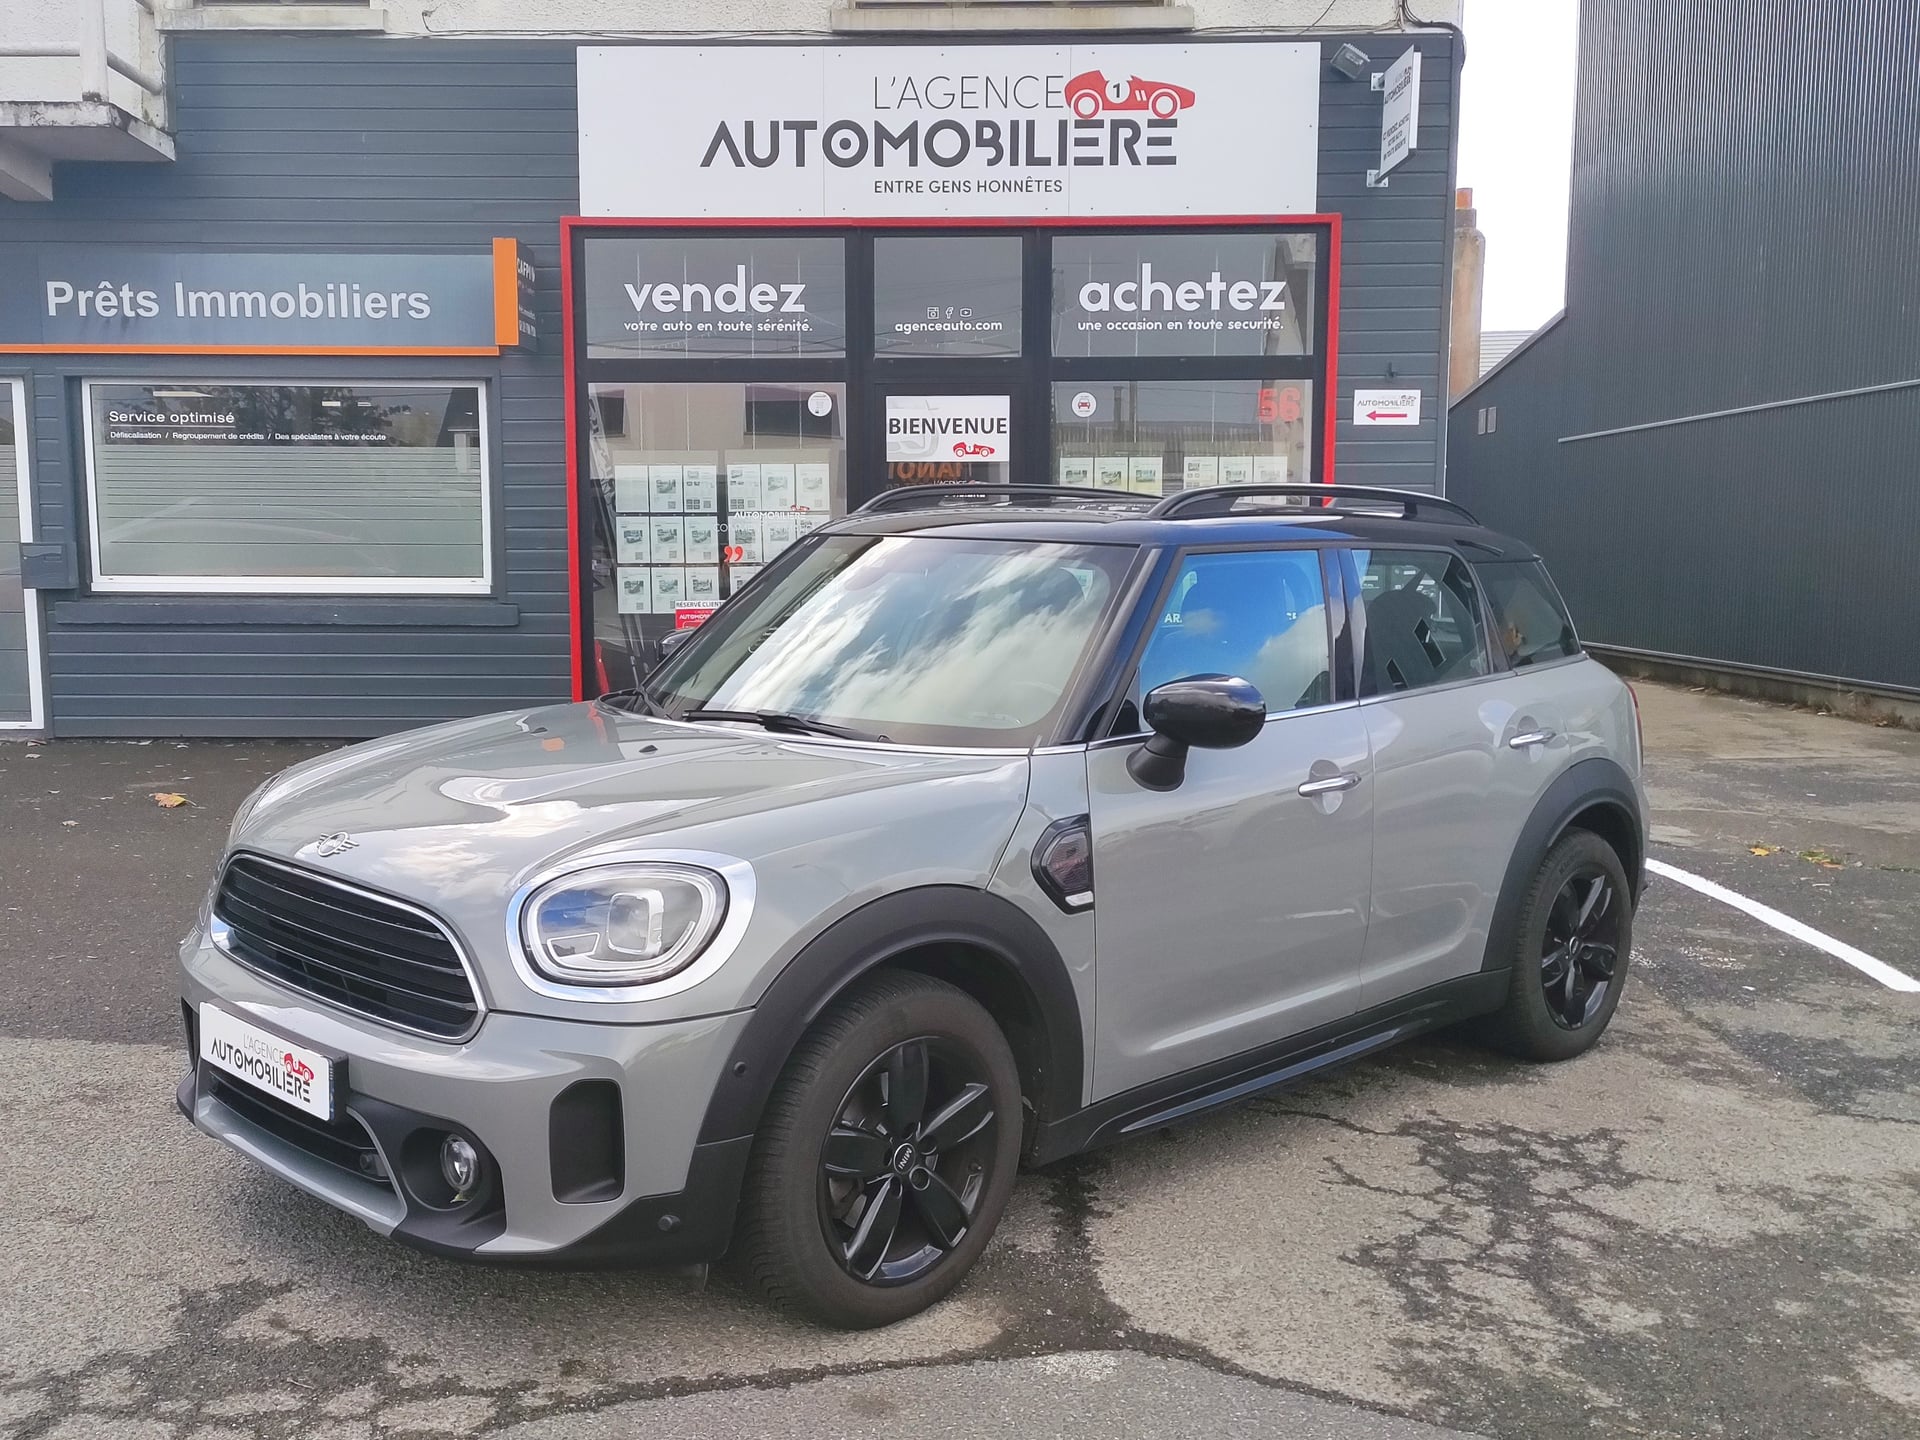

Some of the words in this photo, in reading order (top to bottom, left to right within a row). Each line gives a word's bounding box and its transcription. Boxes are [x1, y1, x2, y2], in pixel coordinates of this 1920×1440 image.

[873, 74, 1065, 111] L'AGENCE
[700, 119, 1178, 168] AUTOMOBILIERE
[874, 180, 925, 195] ENTRE
[930, 179, 972, 194] GENS
[976, 175, 1063, 194] HONNÊTES
[623, 264, 807, 313] vendez
[1078, 262, 1287, 313] achetez
[46, 280, 160, 318] Prêts
[174, 281, 432, 319] Immobiliers
[623, 320, 658, 332] votre
[662, 320, 693, 332] auto
[697, 321, 713, 332] en
[717, 320, 753, 332] toute
[757, 318, 813, 332] sérénité.
[894, 320, 1003, 334] agenceauto.com
[1077, 321, 1102, 331] une
[1106, 317, 1163, 331] occasion
[1166, 321, 1183, 330] en
[1187, 319, 1224, 330] toute
[109, 411, 165, 424] Service
[169, 411, 235, 426] optimisé
[888, 417, 1007, 435] BIENVENUE
[110, 431, 162, 440] Défiscalisation
[172, 432, 227, 442] Regroupement
[228, 432, 238, 440] de
[239, 432, 265, 441] crédits
[275, 433, 290, 441] Des
[291, 432, 333, 442] spécialistes
[361, 433, 387, 441] écoute
[211, 1037, 311, 1104] AUTOMOBILIERE
[898, 1147, 913, 1170] MINI
